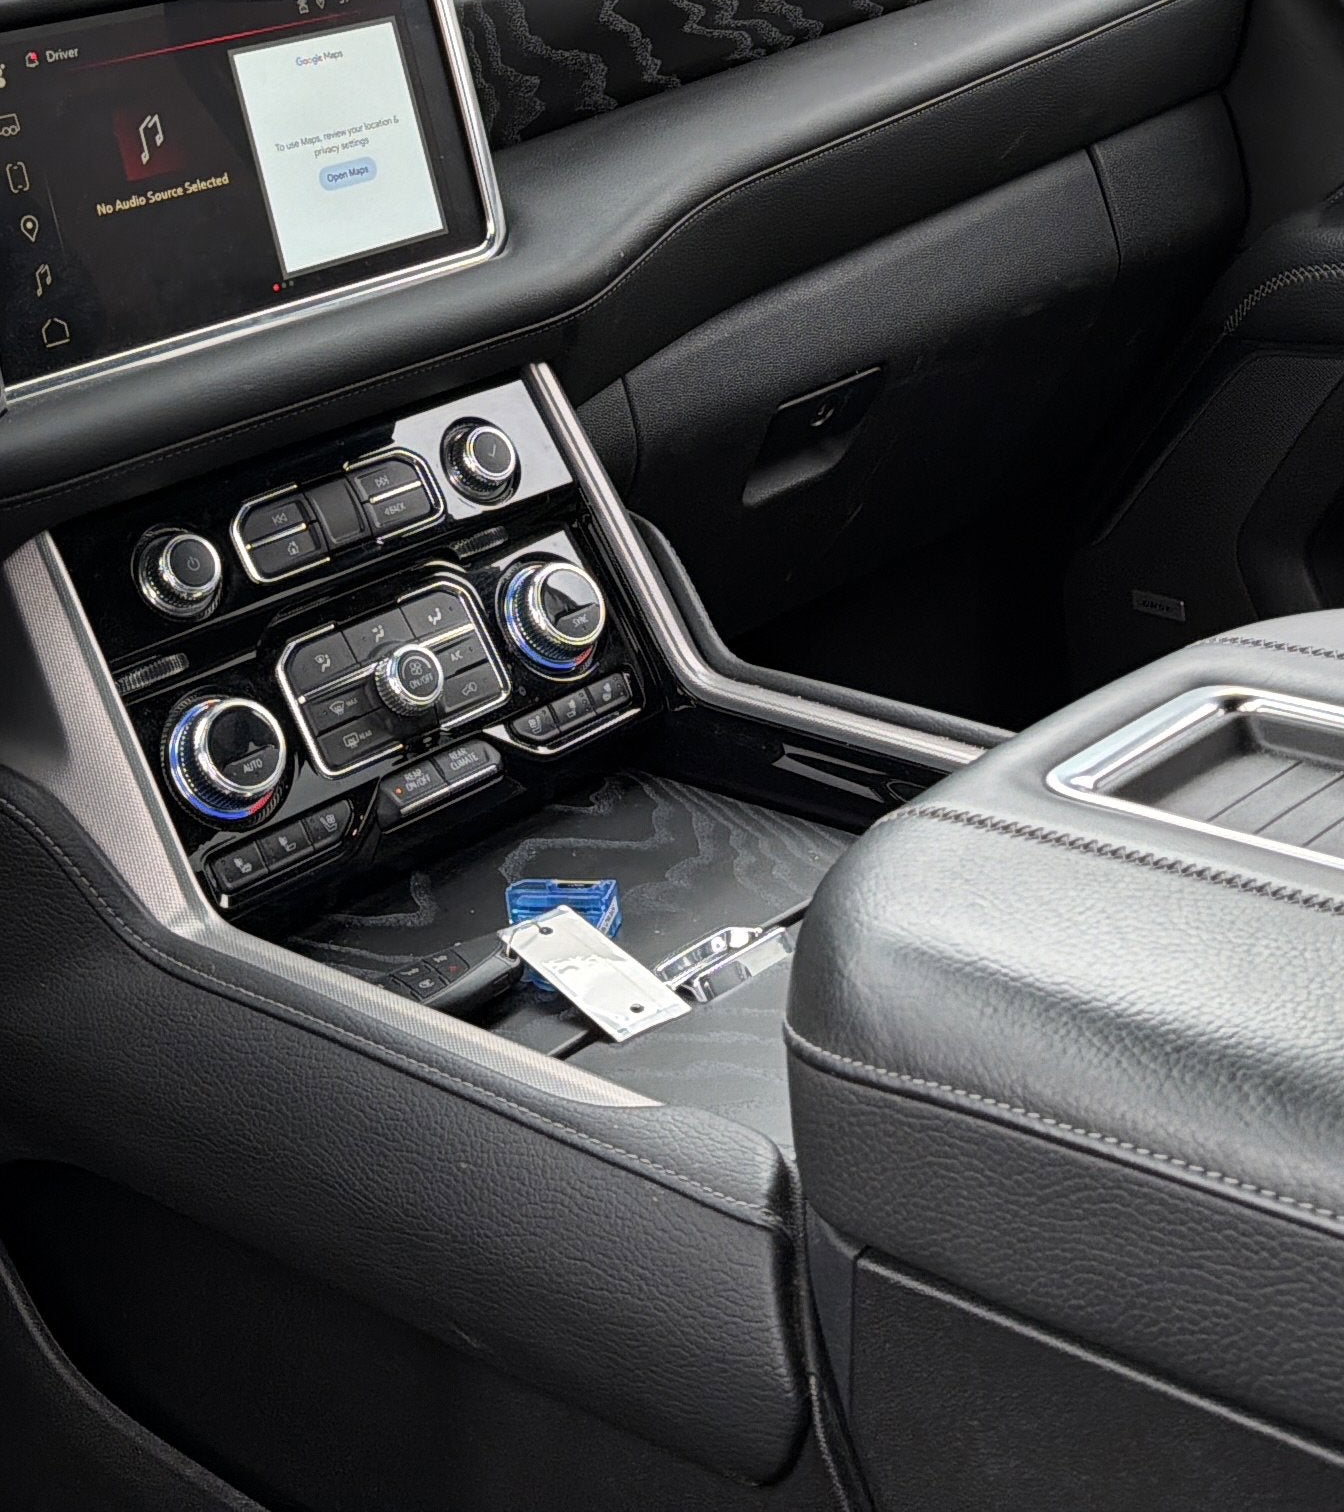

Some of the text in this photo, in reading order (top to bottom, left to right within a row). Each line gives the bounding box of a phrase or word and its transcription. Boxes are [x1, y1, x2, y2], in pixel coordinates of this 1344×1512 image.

[45, 47, 79, 63] Driver
[296, 49, 343, 66] Google Maps
[326, 165, 369, 184] Open Maps
[96, 172, 229, 216] No Audio Source Selected
[408, 672, 434, 690] ON/OFF
[243, 757, 263, 774] AUTO
[450, 752, 479, 771] CLIMATE
